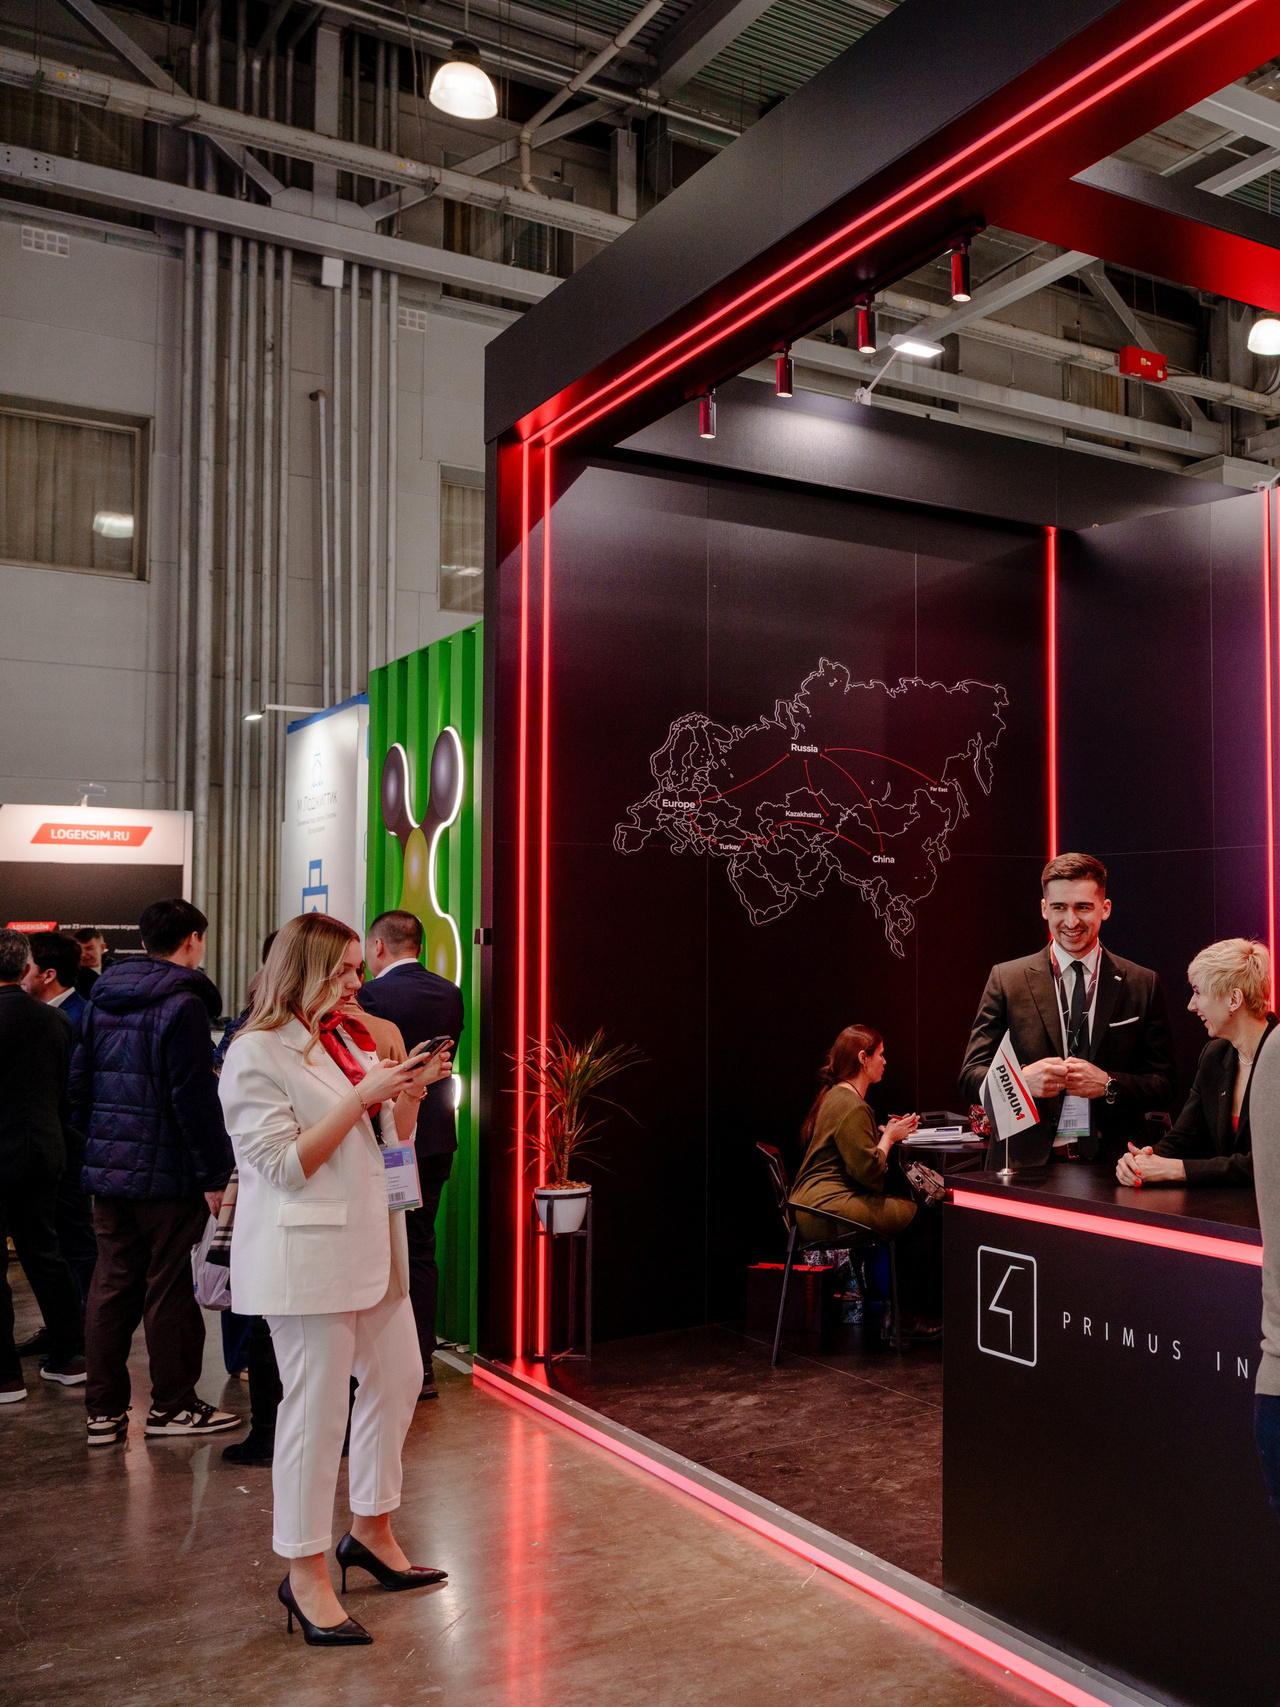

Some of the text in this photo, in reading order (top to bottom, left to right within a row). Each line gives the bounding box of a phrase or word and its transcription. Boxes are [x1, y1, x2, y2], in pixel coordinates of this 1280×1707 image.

[791, 743, 818, 753] Russia
[662, 799, 696, 810] Europe
[785, 810, 822, 819] Kazakhstan
[50, 828, 130, 841] LOGEKSIM.RU
[719, 843, 741, 852] Turkey
[872, 855, 895, 864] China
[996, 1064, 1025, 1121] PRIMUM
[1062, 1311, 1181, 1360] PRIMUS
[1216, 1351, 1248, 1379] IN
